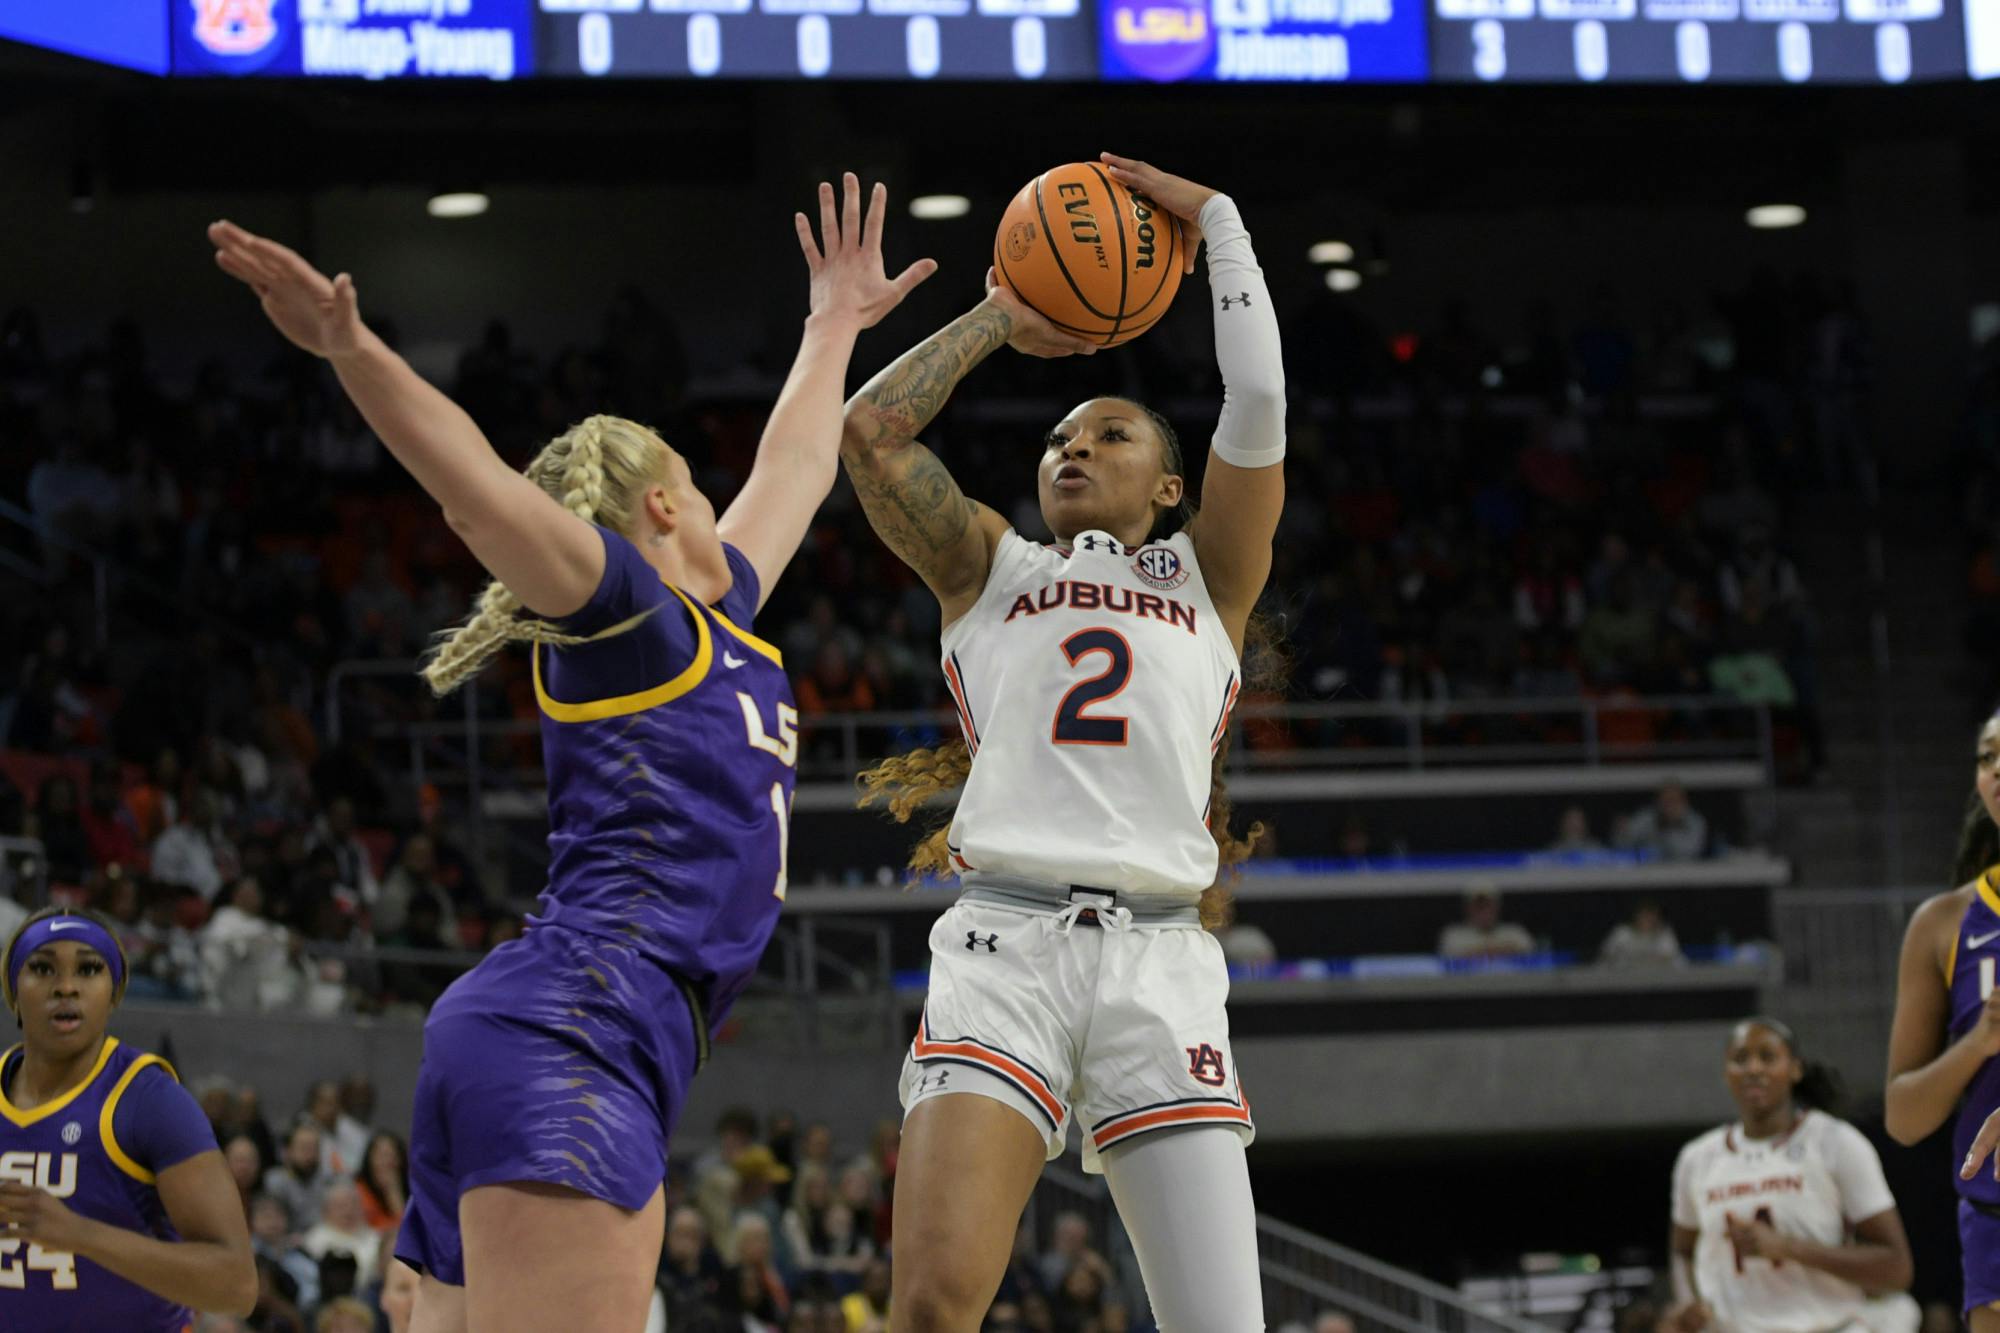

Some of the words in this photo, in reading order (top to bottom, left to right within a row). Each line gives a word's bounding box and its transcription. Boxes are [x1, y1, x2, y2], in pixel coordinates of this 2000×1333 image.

[577, 12, 614, 76] 0
[686, 12, 722, 77] 0
[797, 13, 833, 78] 0
[905, 14, 942, 79] 0
[1011, 15, 1047, 79] 0
[1115, 8, 1206, 43] LSU
[1215, 34, 1348, 80] Johnson
[1471, 19, 1507, 82] 3
[1572, 19, 1609, 83] 0
[1675, 19, 1711, 83] 0
[1776, 20, 1813, 84] 0
[1874, 21, 1912, 85] 0
[1135, 570, 1181, 588] GRADUATE
[1140, 550, 1178, 578] SEC
[1004, 580, 1197, 636] AUBURN
[1052, 626, 1133, 746] 2
[1707, 1174, 1804, 1205] AUBURN
